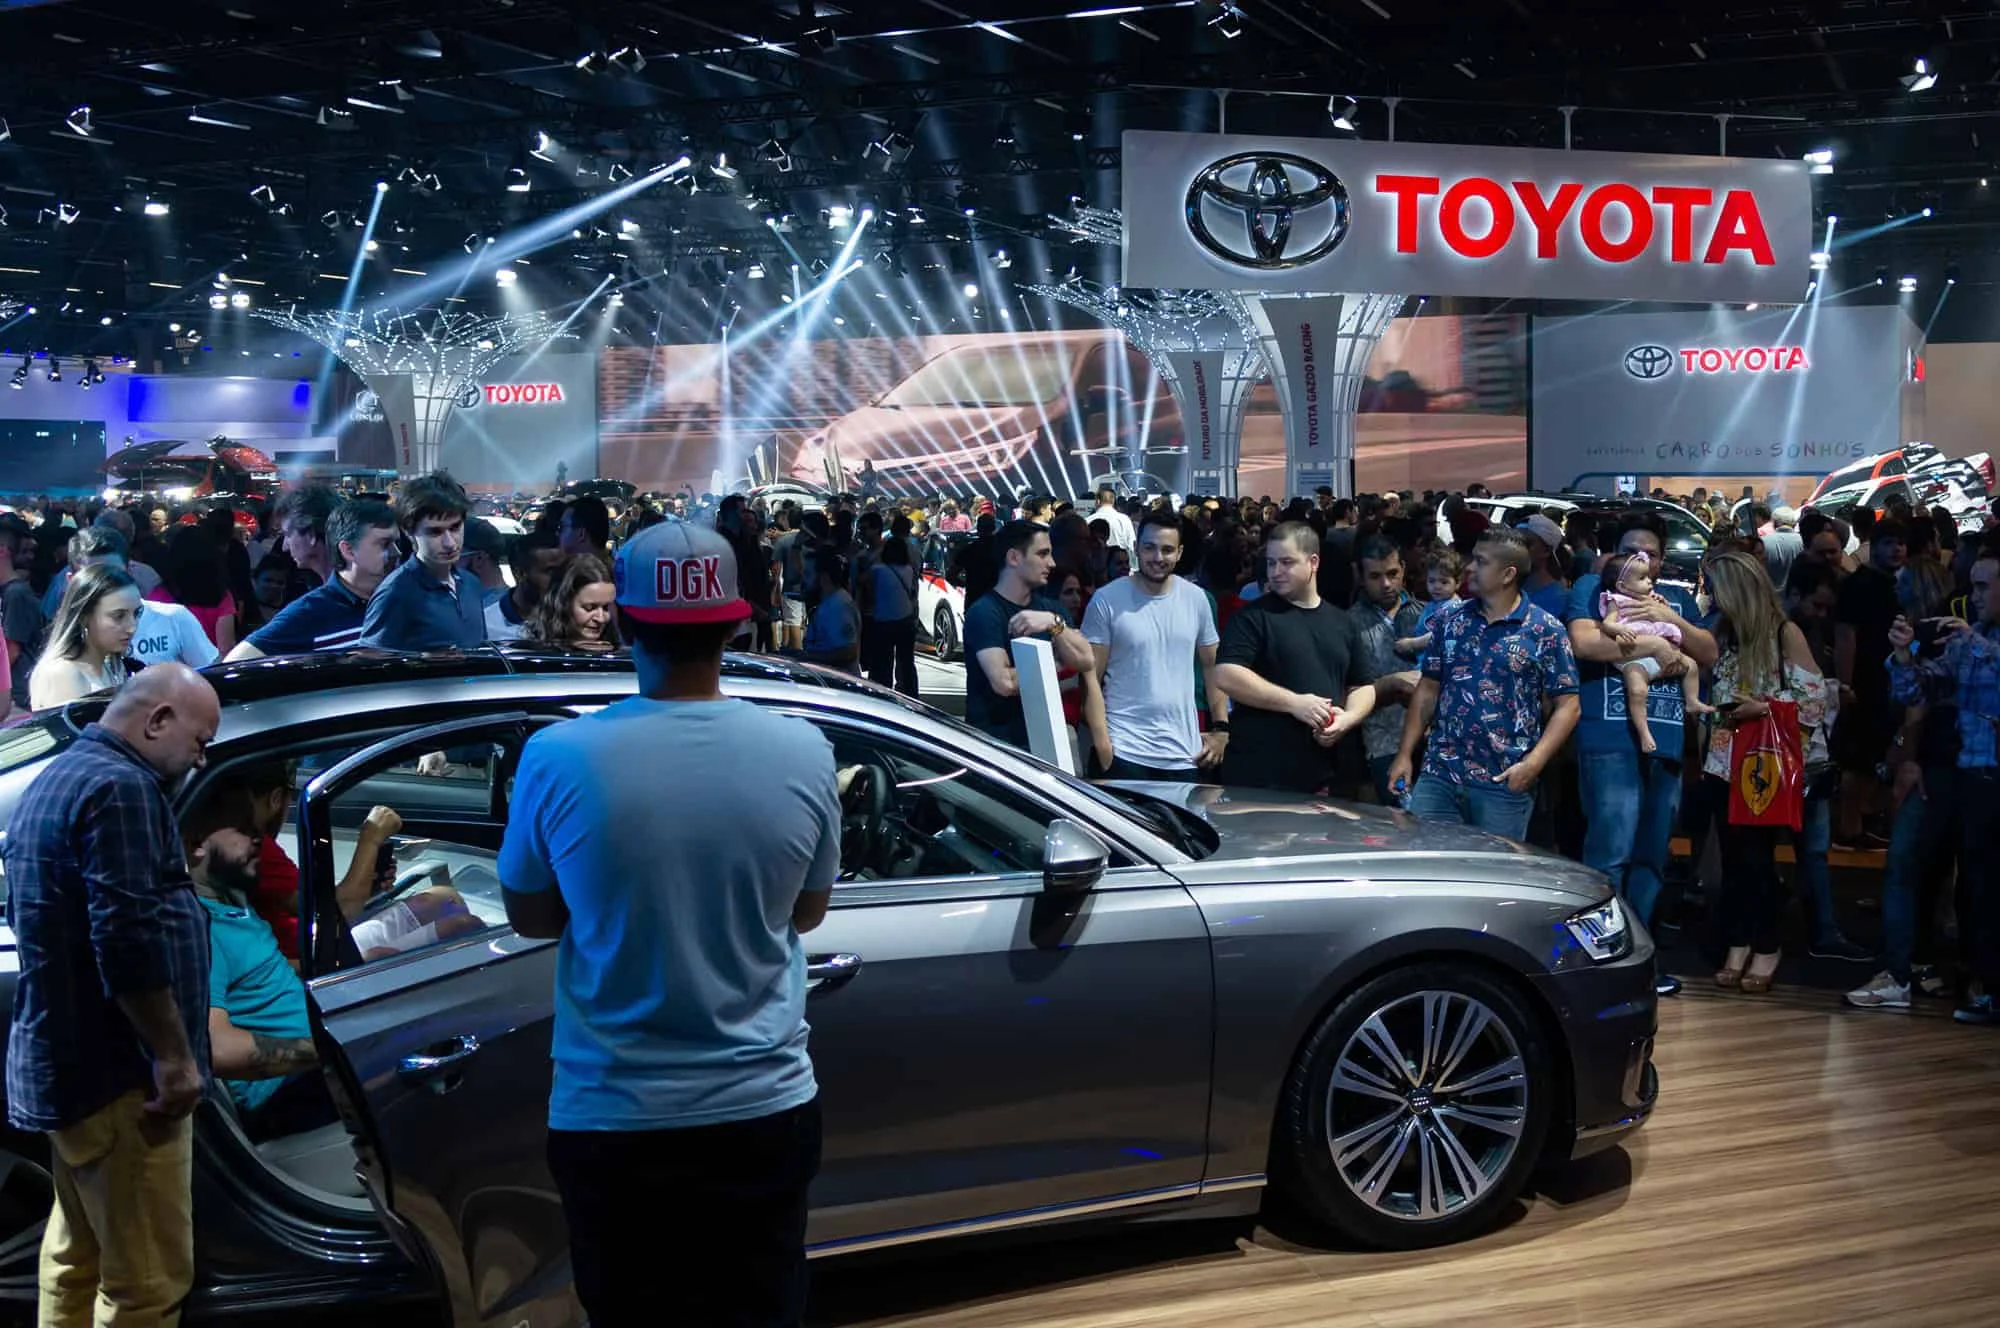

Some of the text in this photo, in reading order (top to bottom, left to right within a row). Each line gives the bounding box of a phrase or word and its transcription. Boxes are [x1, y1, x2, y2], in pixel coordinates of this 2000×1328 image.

[1376, 175, 1775, 265] TOYOTA
[1680, 347, 1809, 372] TOYOTA
[484, 384, 563, 403] TOYOTA
[1301, 323, 1318, 447] TOYOTA GAZOO RACING
[1193, 360, 1211, 460] FUTURO DA MOBILIDADE
[1656, 441, 1729, 460] CARRO
[1770, 440, 1865, 458] SONHOS
[656, 554, 725, 602] DGK
[138, 636, 168, 654] ONE
